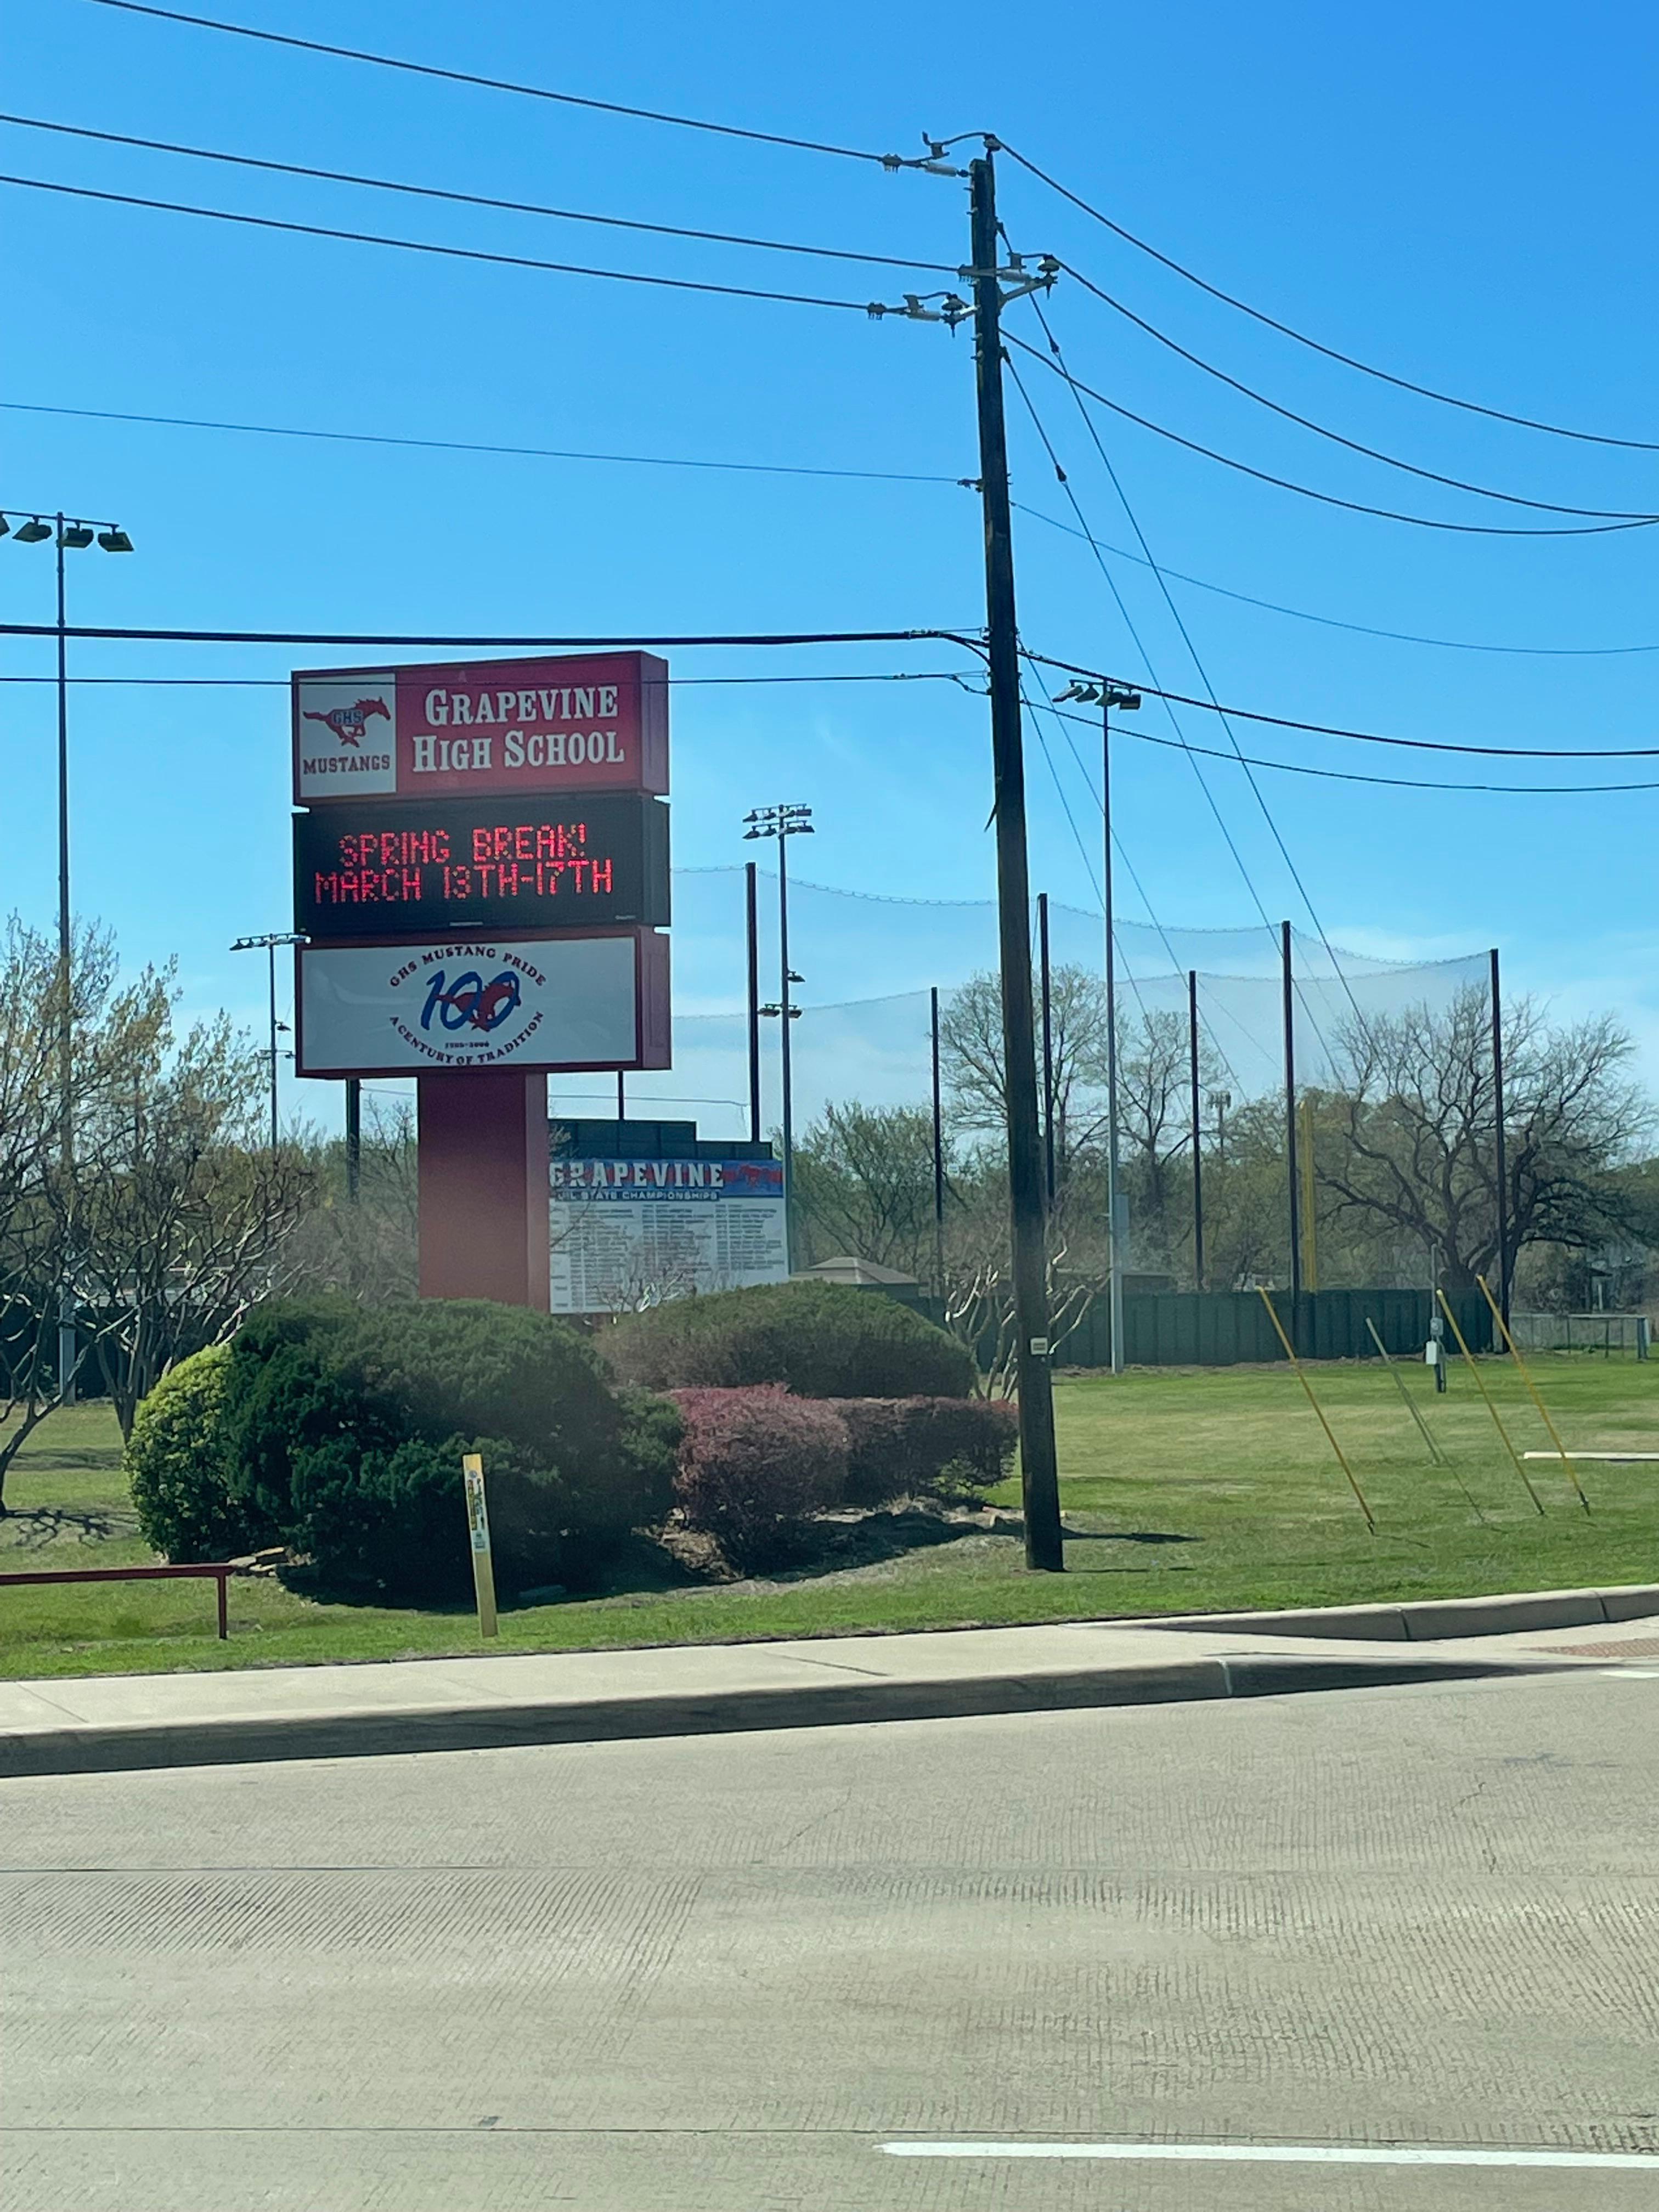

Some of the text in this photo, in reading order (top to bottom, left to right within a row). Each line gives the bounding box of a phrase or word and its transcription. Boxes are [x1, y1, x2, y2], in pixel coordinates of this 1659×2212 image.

[332, 709, 363, 725] GHS
[424, 686, 619, 726] GRAPEVINE
[302, 754, 391, 775] MUSTANGS
[413, 730, 625, 773] HIGH SCHOOL
[339, 822, 587, 867] SPRING BREAK!
[314, 858, 613, 904] MARCH 13TH-17TH
[390, 946, 547, 987] GHS MUSTANG PRIDE
[420, 969, 520, 1031] 100
[389, 1011, 544, 1065] A CENTURY OF TRADITION
[549, 1162, 724, 1188] GRAPEVINE
[622, 1190, 718, 1201] CHAMPIONSHIPS
